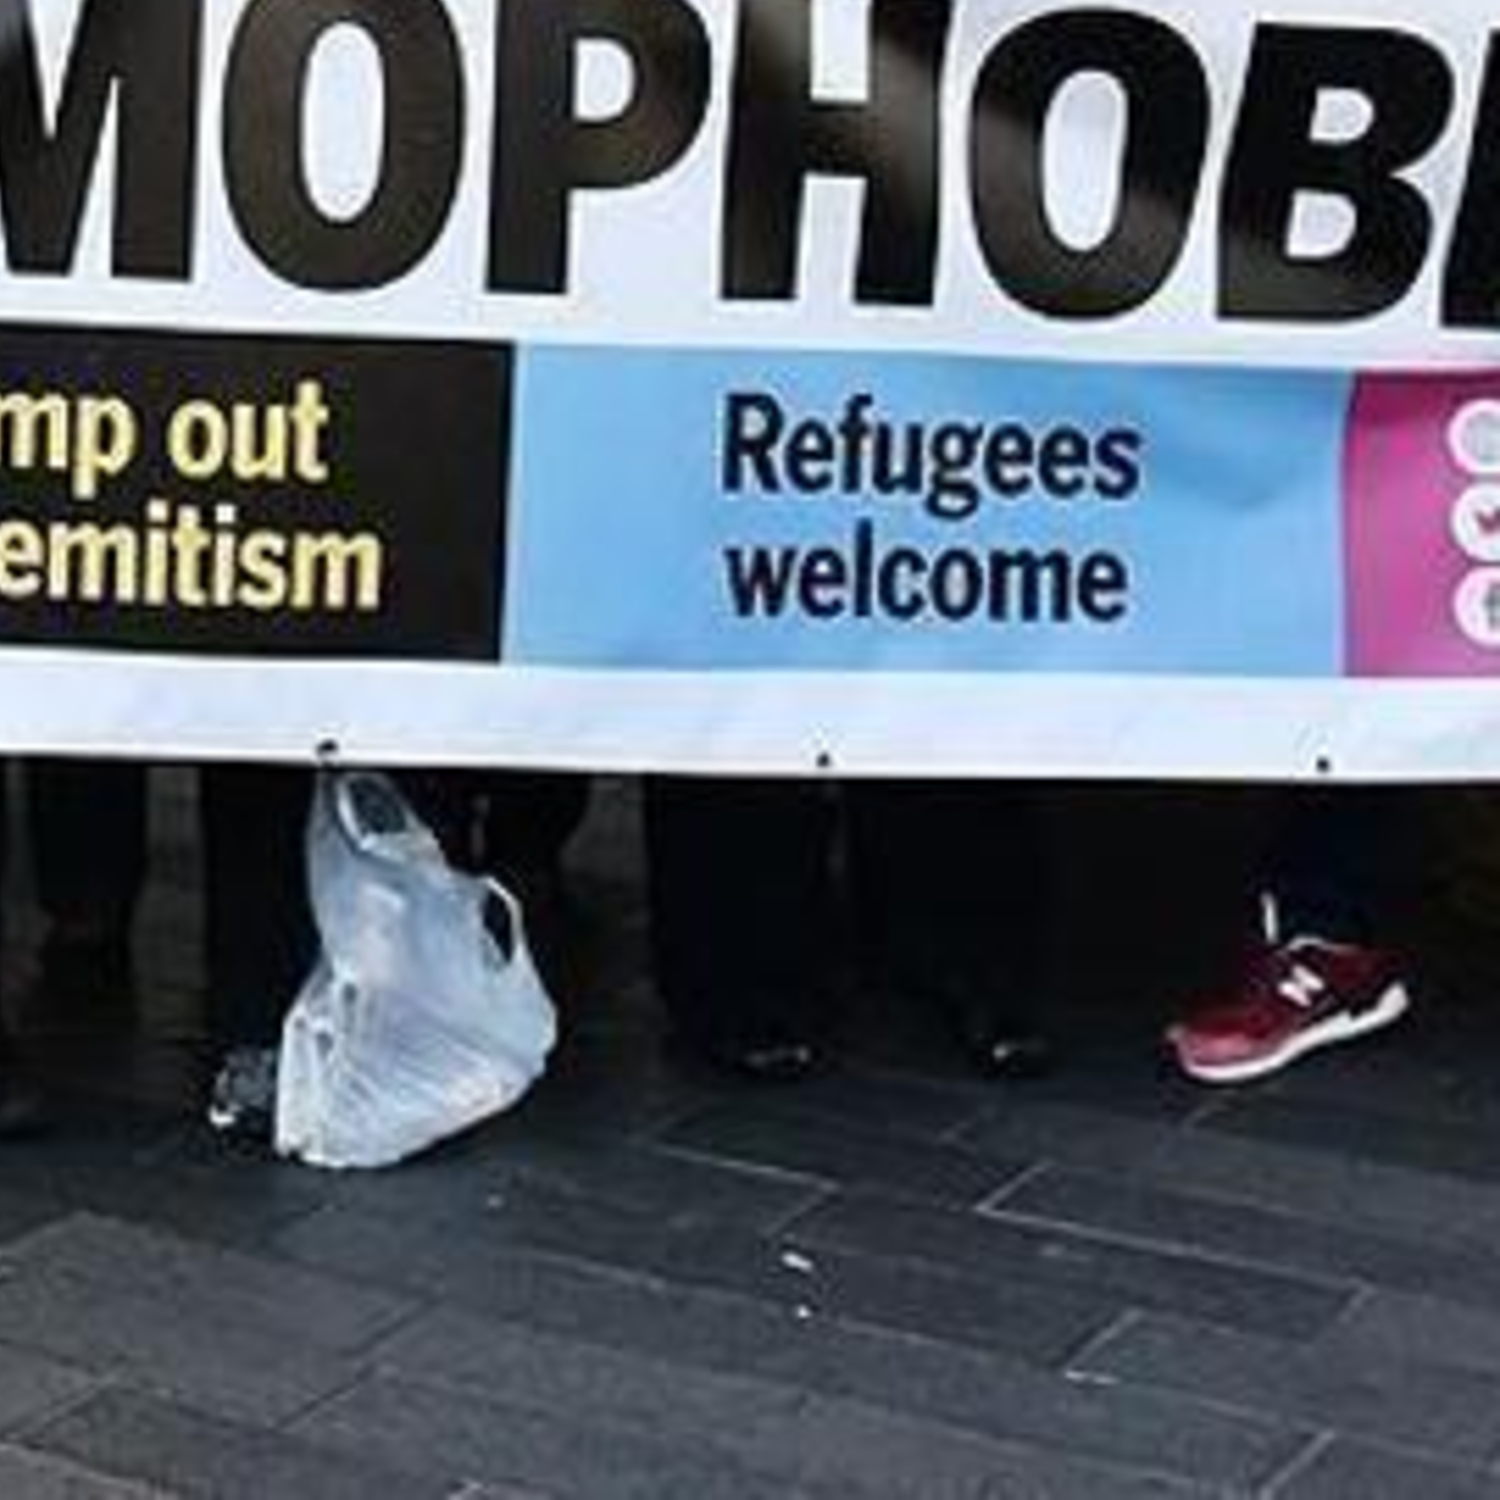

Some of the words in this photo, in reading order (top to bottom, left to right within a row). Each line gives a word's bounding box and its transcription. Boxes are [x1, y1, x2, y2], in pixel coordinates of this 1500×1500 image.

[167, 380, 329, 483] out
[721, 392, 1142, 516] Refugees
[724, 521, 1129, 623] welcome
